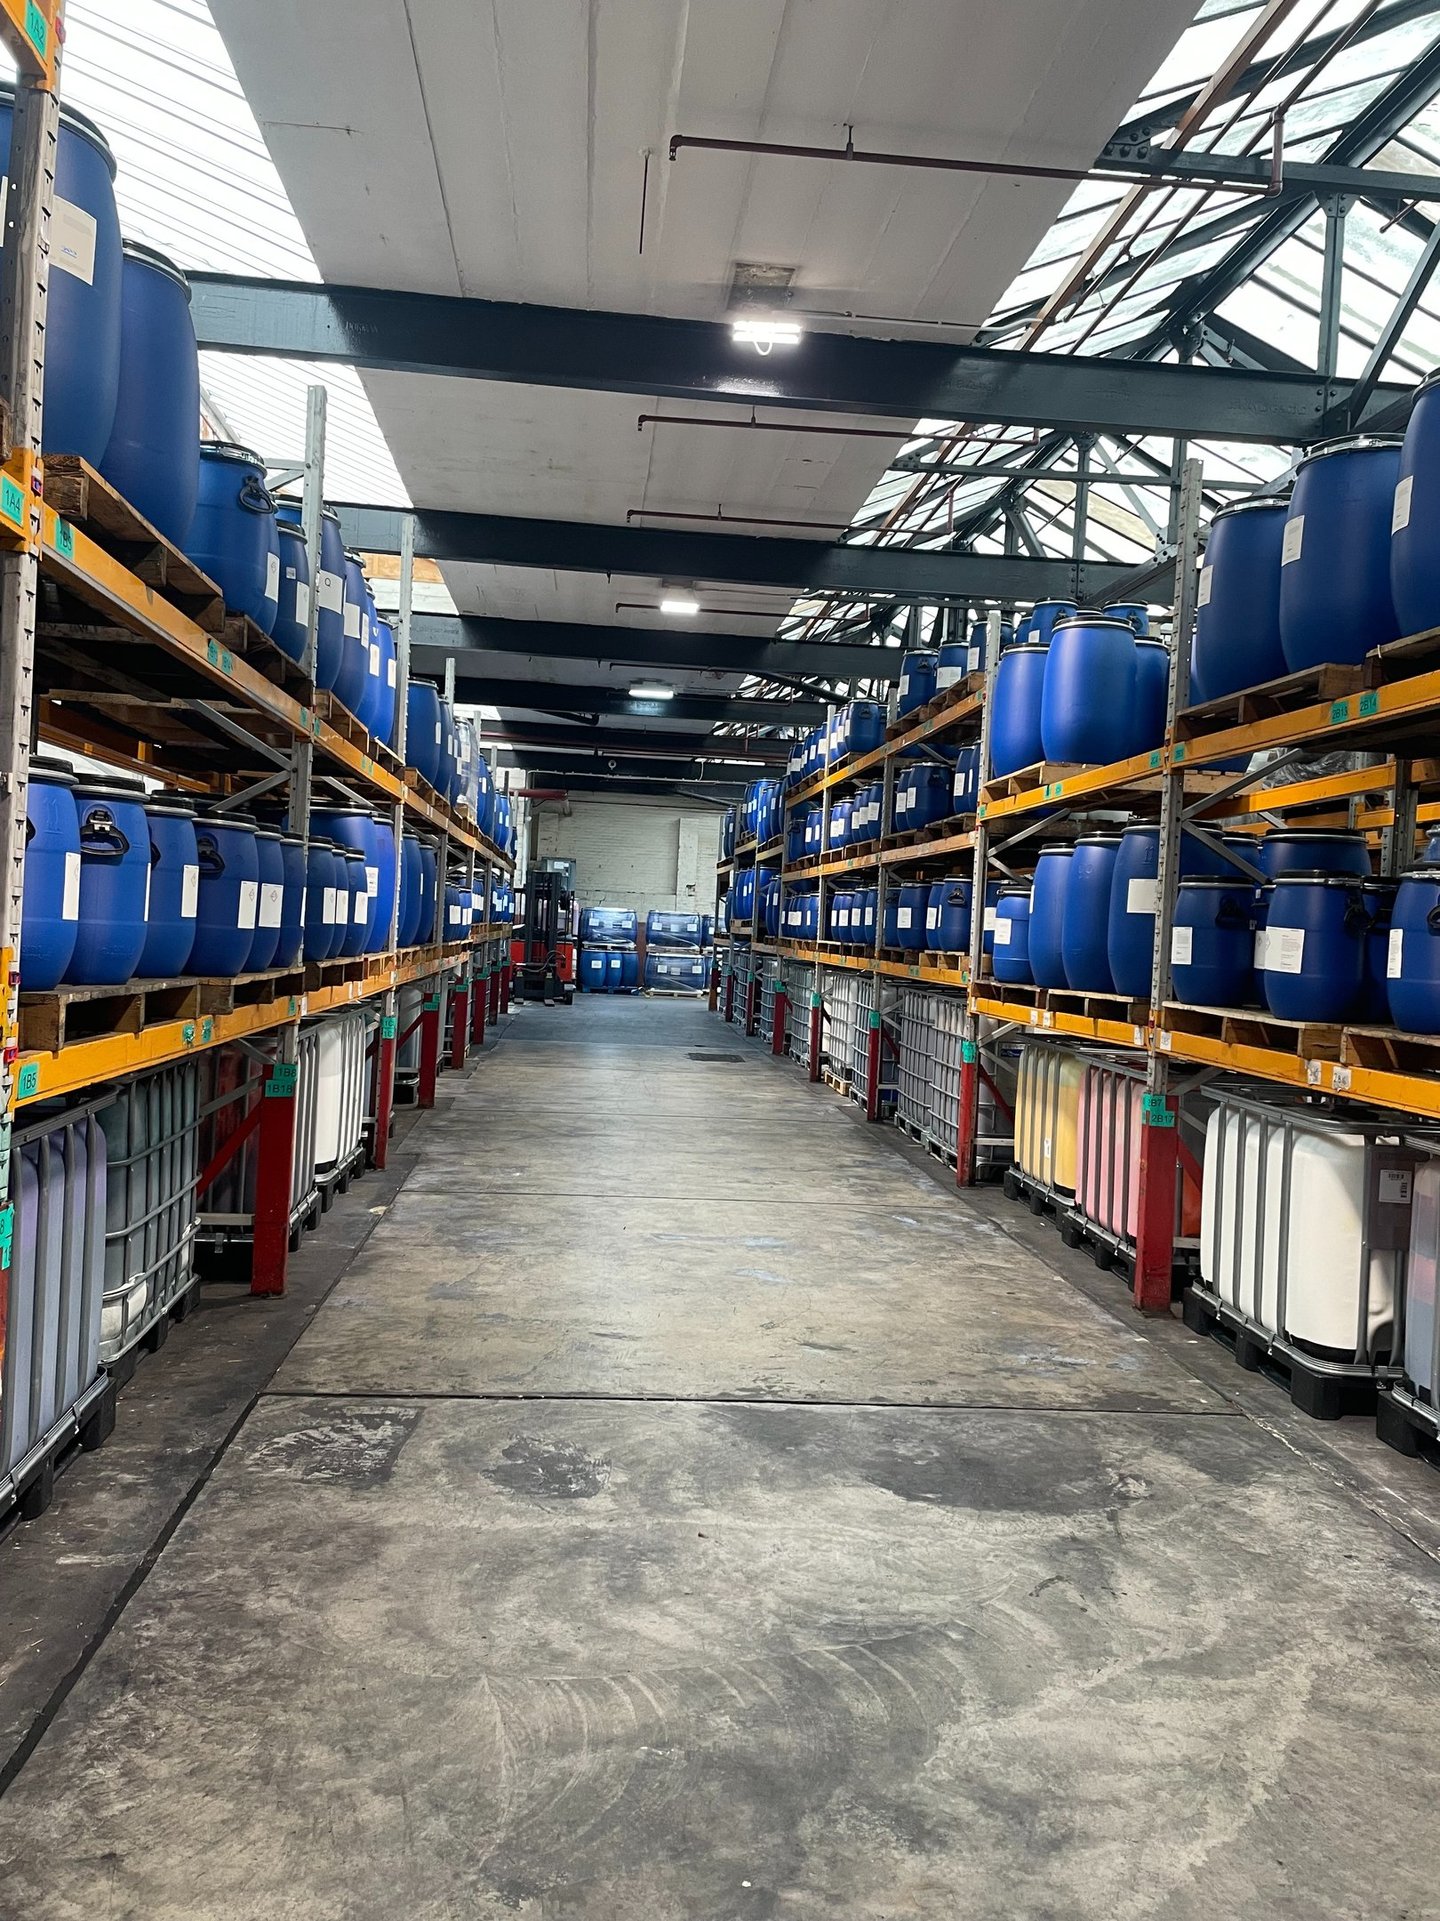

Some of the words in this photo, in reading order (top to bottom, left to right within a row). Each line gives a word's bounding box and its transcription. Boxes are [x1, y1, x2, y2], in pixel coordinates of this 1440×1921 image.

[6, 489, 20, 515] 1A4
[23, 1072, 37, 1090] 1B5
[1151, 1114, 1175, 1123] 2B17
